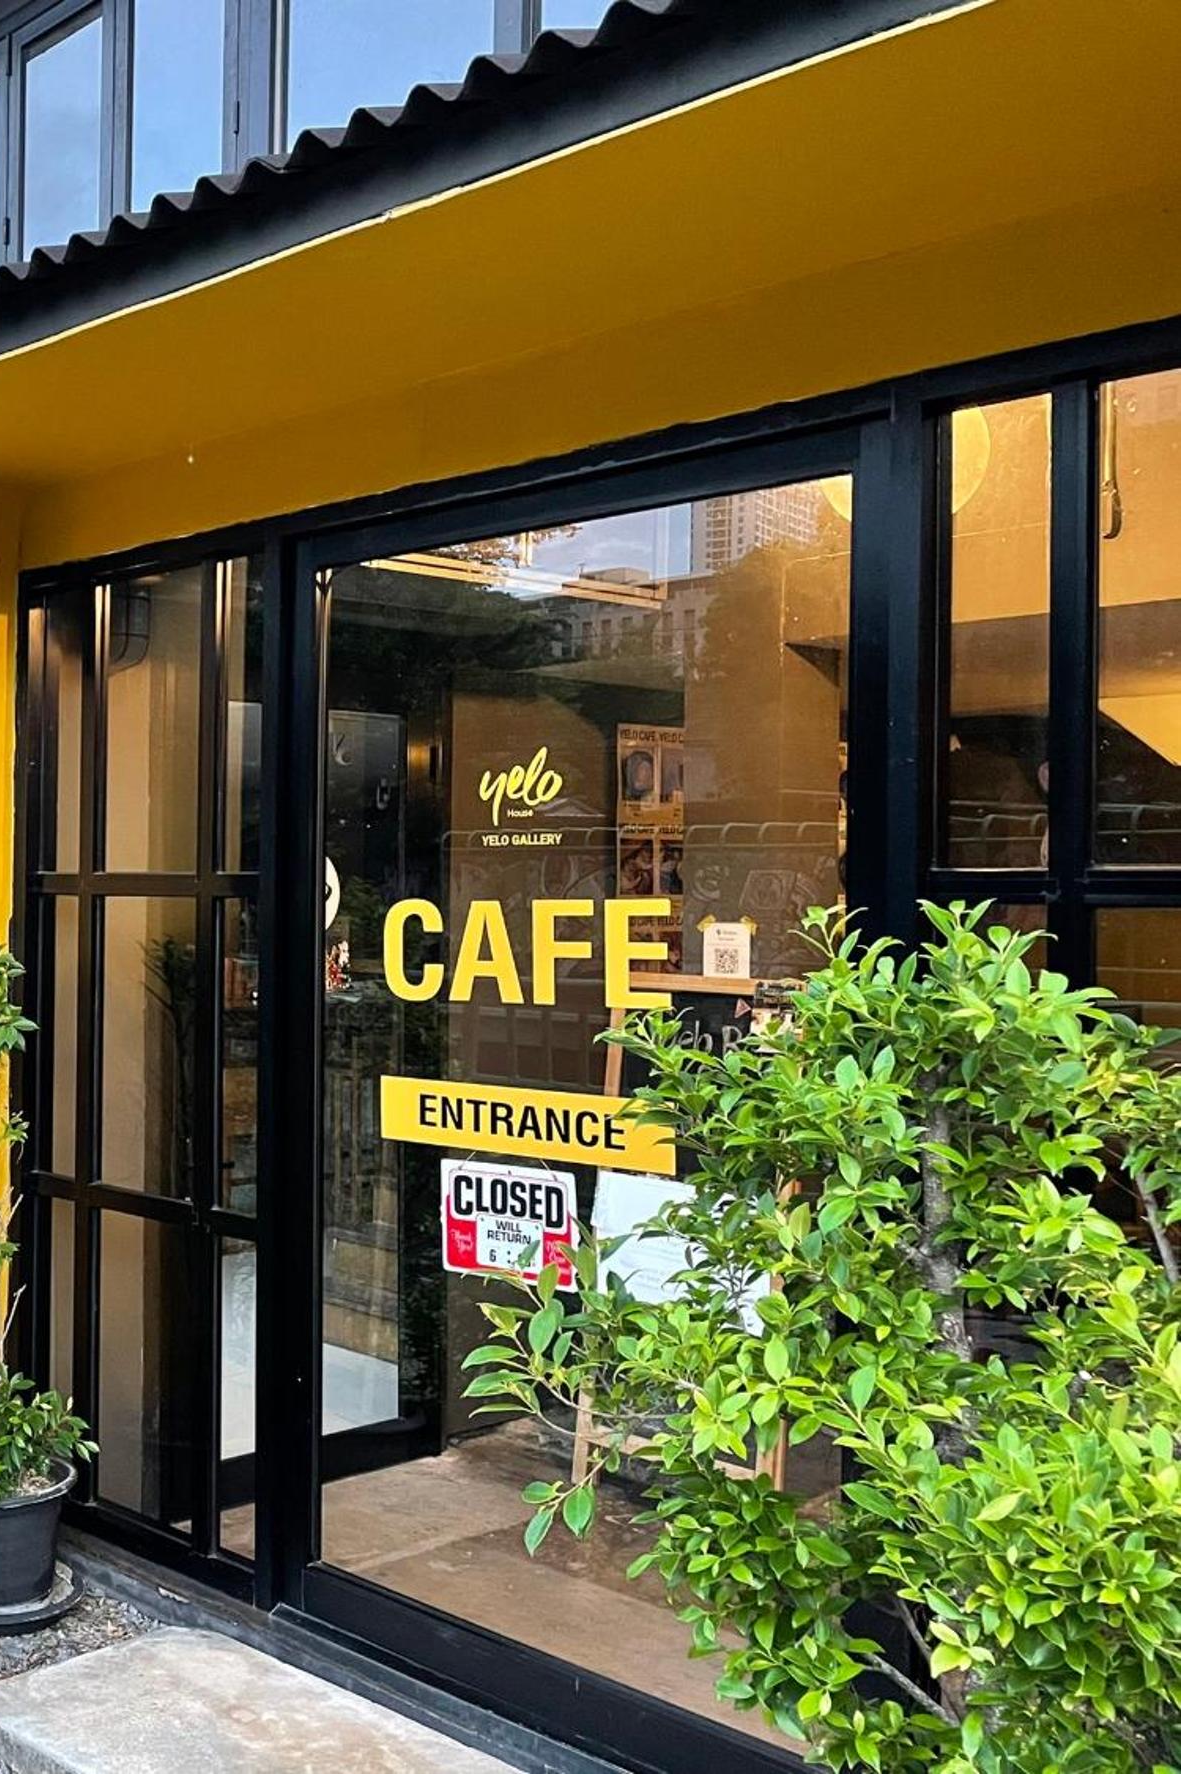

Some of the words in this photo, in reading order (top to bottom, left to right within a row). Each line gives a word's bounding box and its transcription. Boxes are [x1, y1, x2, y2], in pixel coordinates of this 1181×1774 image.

[479, 746, 563, 826] yelo
[482, 834, 509, 846] YELO
[512, 833, 562, 846] GALLERY
[384, 898, 672, 1009] CAFE
[419, 1093, 626, 1150] ENTRANCE
[454, 1174, 564, 1228] CLOSED
[495, 1220, 522, 1233] WILL
[487, 1230, 532, 1245] RETURN
